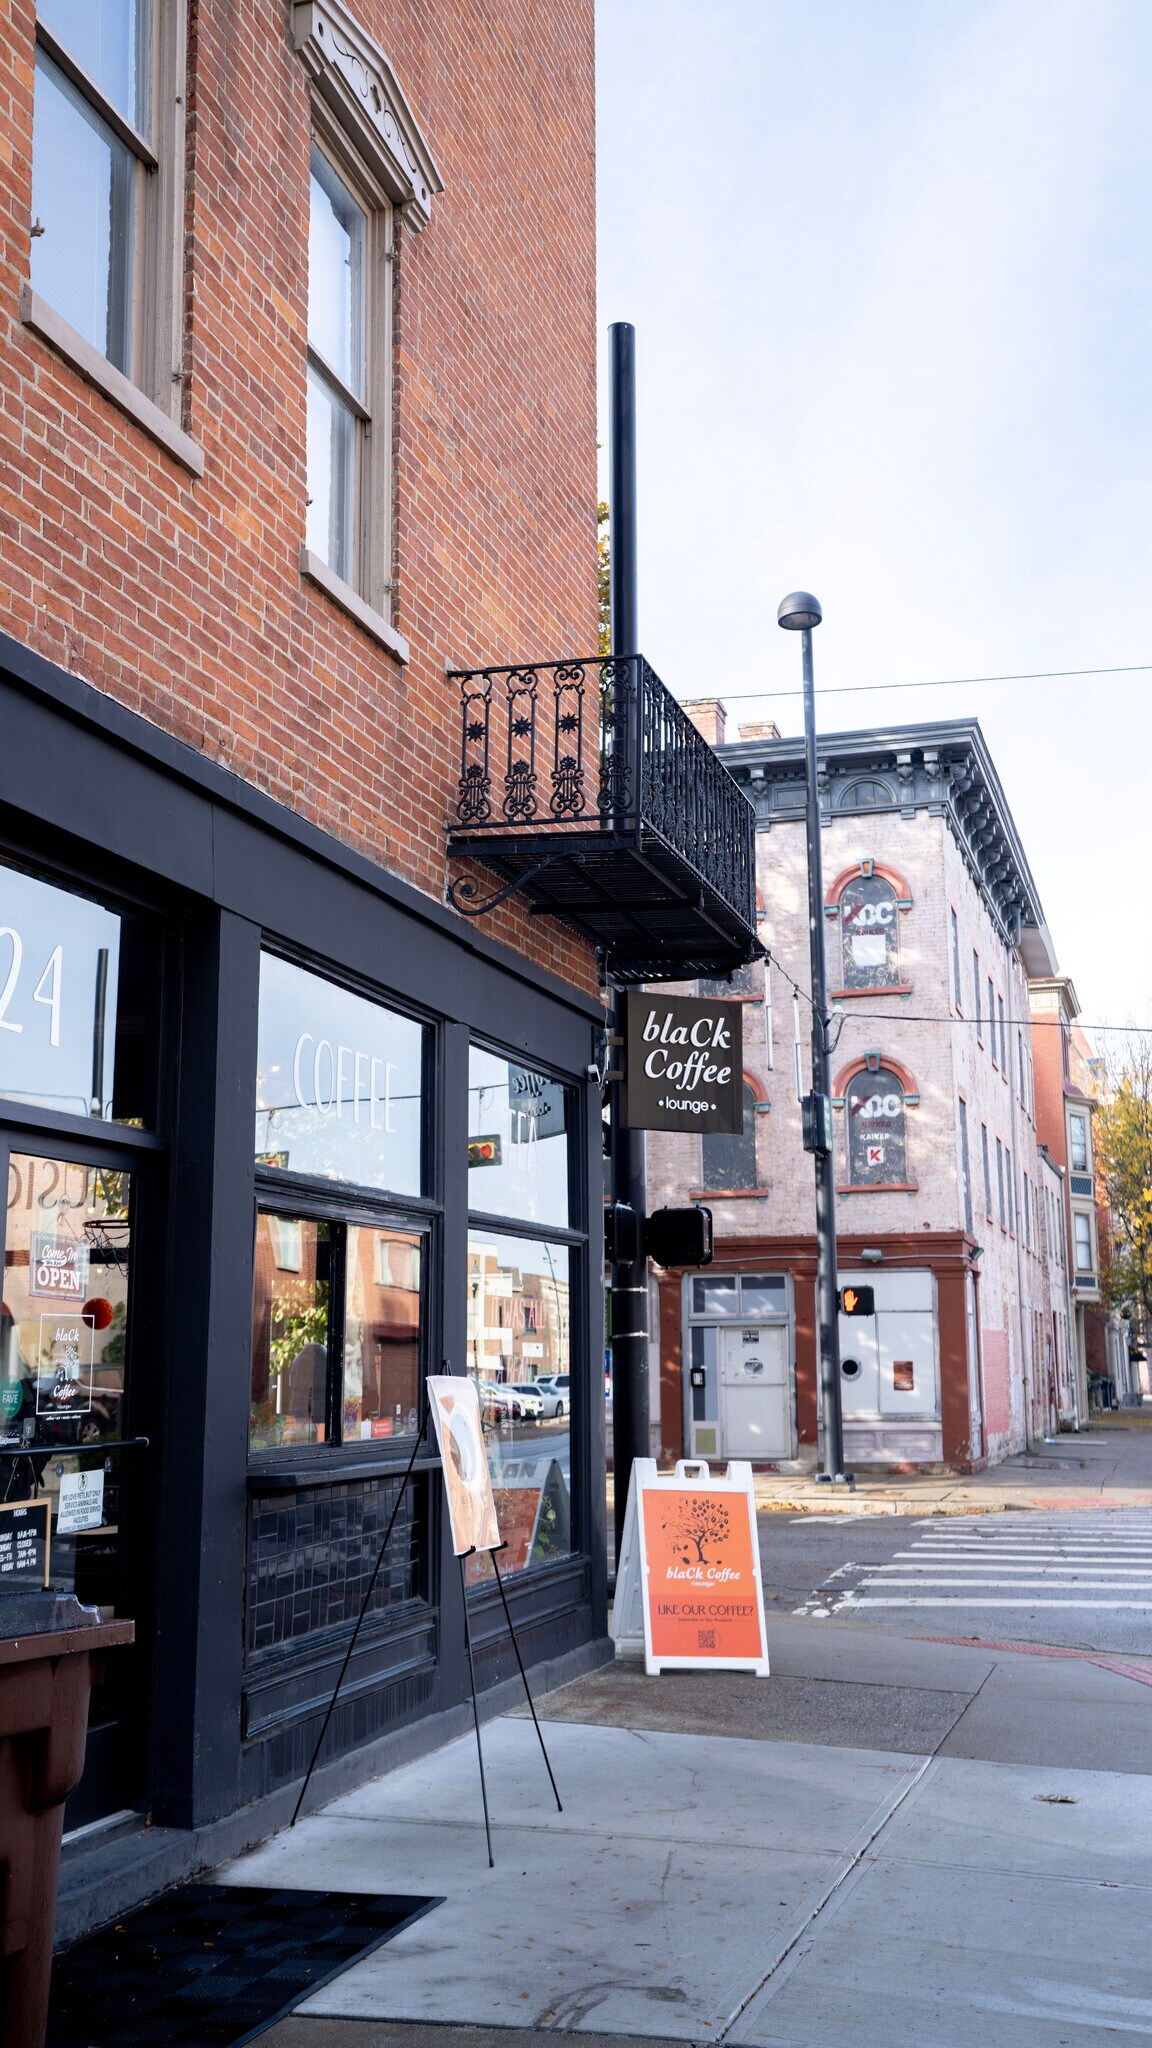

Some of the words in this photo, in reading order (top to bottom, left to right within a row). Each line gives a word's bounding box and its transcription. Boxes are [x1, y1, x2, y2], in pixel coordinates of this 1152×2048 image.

[642, 1010, 731, 1049] blaCk
[644, 1048, 732, 1091] Coffee
[293, 1032, 399, 1134] COFFEE
[504, 1108, 540, 1174] TEA
[860, 1132, 890, 1140] KAIKER
[41, 1244, 65, 1260] Come
[66, 1246, 78, 1261] In
[37, 1266, 81, 1291] OPEN
[491, 1296, 500, 1326] IT
[502, 1298, 526, 1328] WAS
[528, 1300, 545, 1329] ALL
[2, 1394, 18, 1403] FAVE
[53, 1384, 77, 1400] Coffee
[68, 1492, 77, 1501] LOVE
[60, 1510, 76, 1518] ALLOWED
[90, 1505, 101, 1513] SERVICE
[65, 1501, 77, 1509] SERVICE
[13, 1508, 27, 1517] HOURS
[73, 1515, 88, 1523] FACILITIES
[17, 1539, 32, 1549] CLOSED
[666, 1565, 704, 1580] blaCk
[706, 1567, 741, 1582] Coffee
[657, 1604, 679, 1615] LIKE
[682, 1604, 706, 1616] OUR
[708, 1605, 753, 1617] COFFEE?
